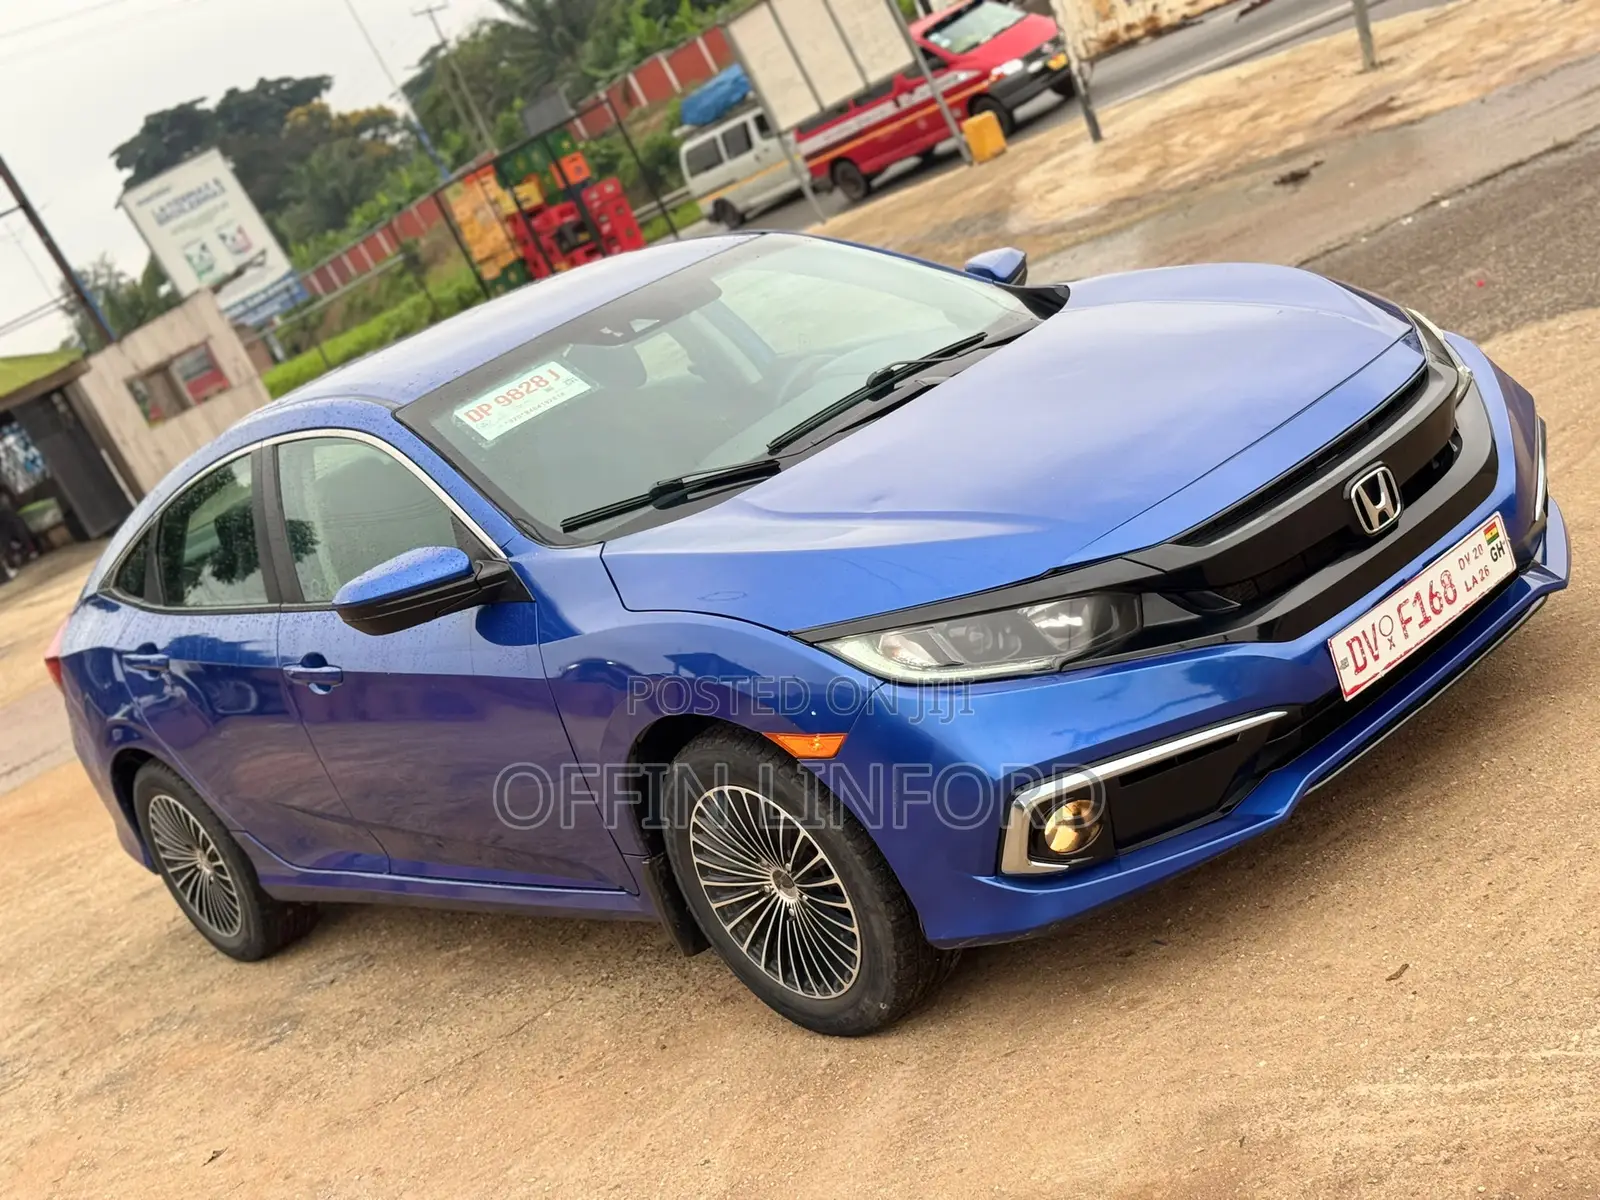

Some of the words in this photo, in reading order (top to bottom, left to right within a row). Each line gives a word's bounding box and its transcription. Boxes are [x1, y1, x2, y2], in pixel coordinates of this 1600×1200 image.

[464, 403, 493, 422] DP
[494, 375, 549, 407] 9828
[548, 368, 561, 381] J
[1458, 552, 1471, 571] DV
[1472, 543, 1484, 560] 20
[1490, 540, 1506, 562] GH
[1464, 574, 1479, 592] LA
[1478, 564, 1490, 582] 26
[1345, 622, 1380, 676] DV
[1396, 569, 1457, 640] F168
